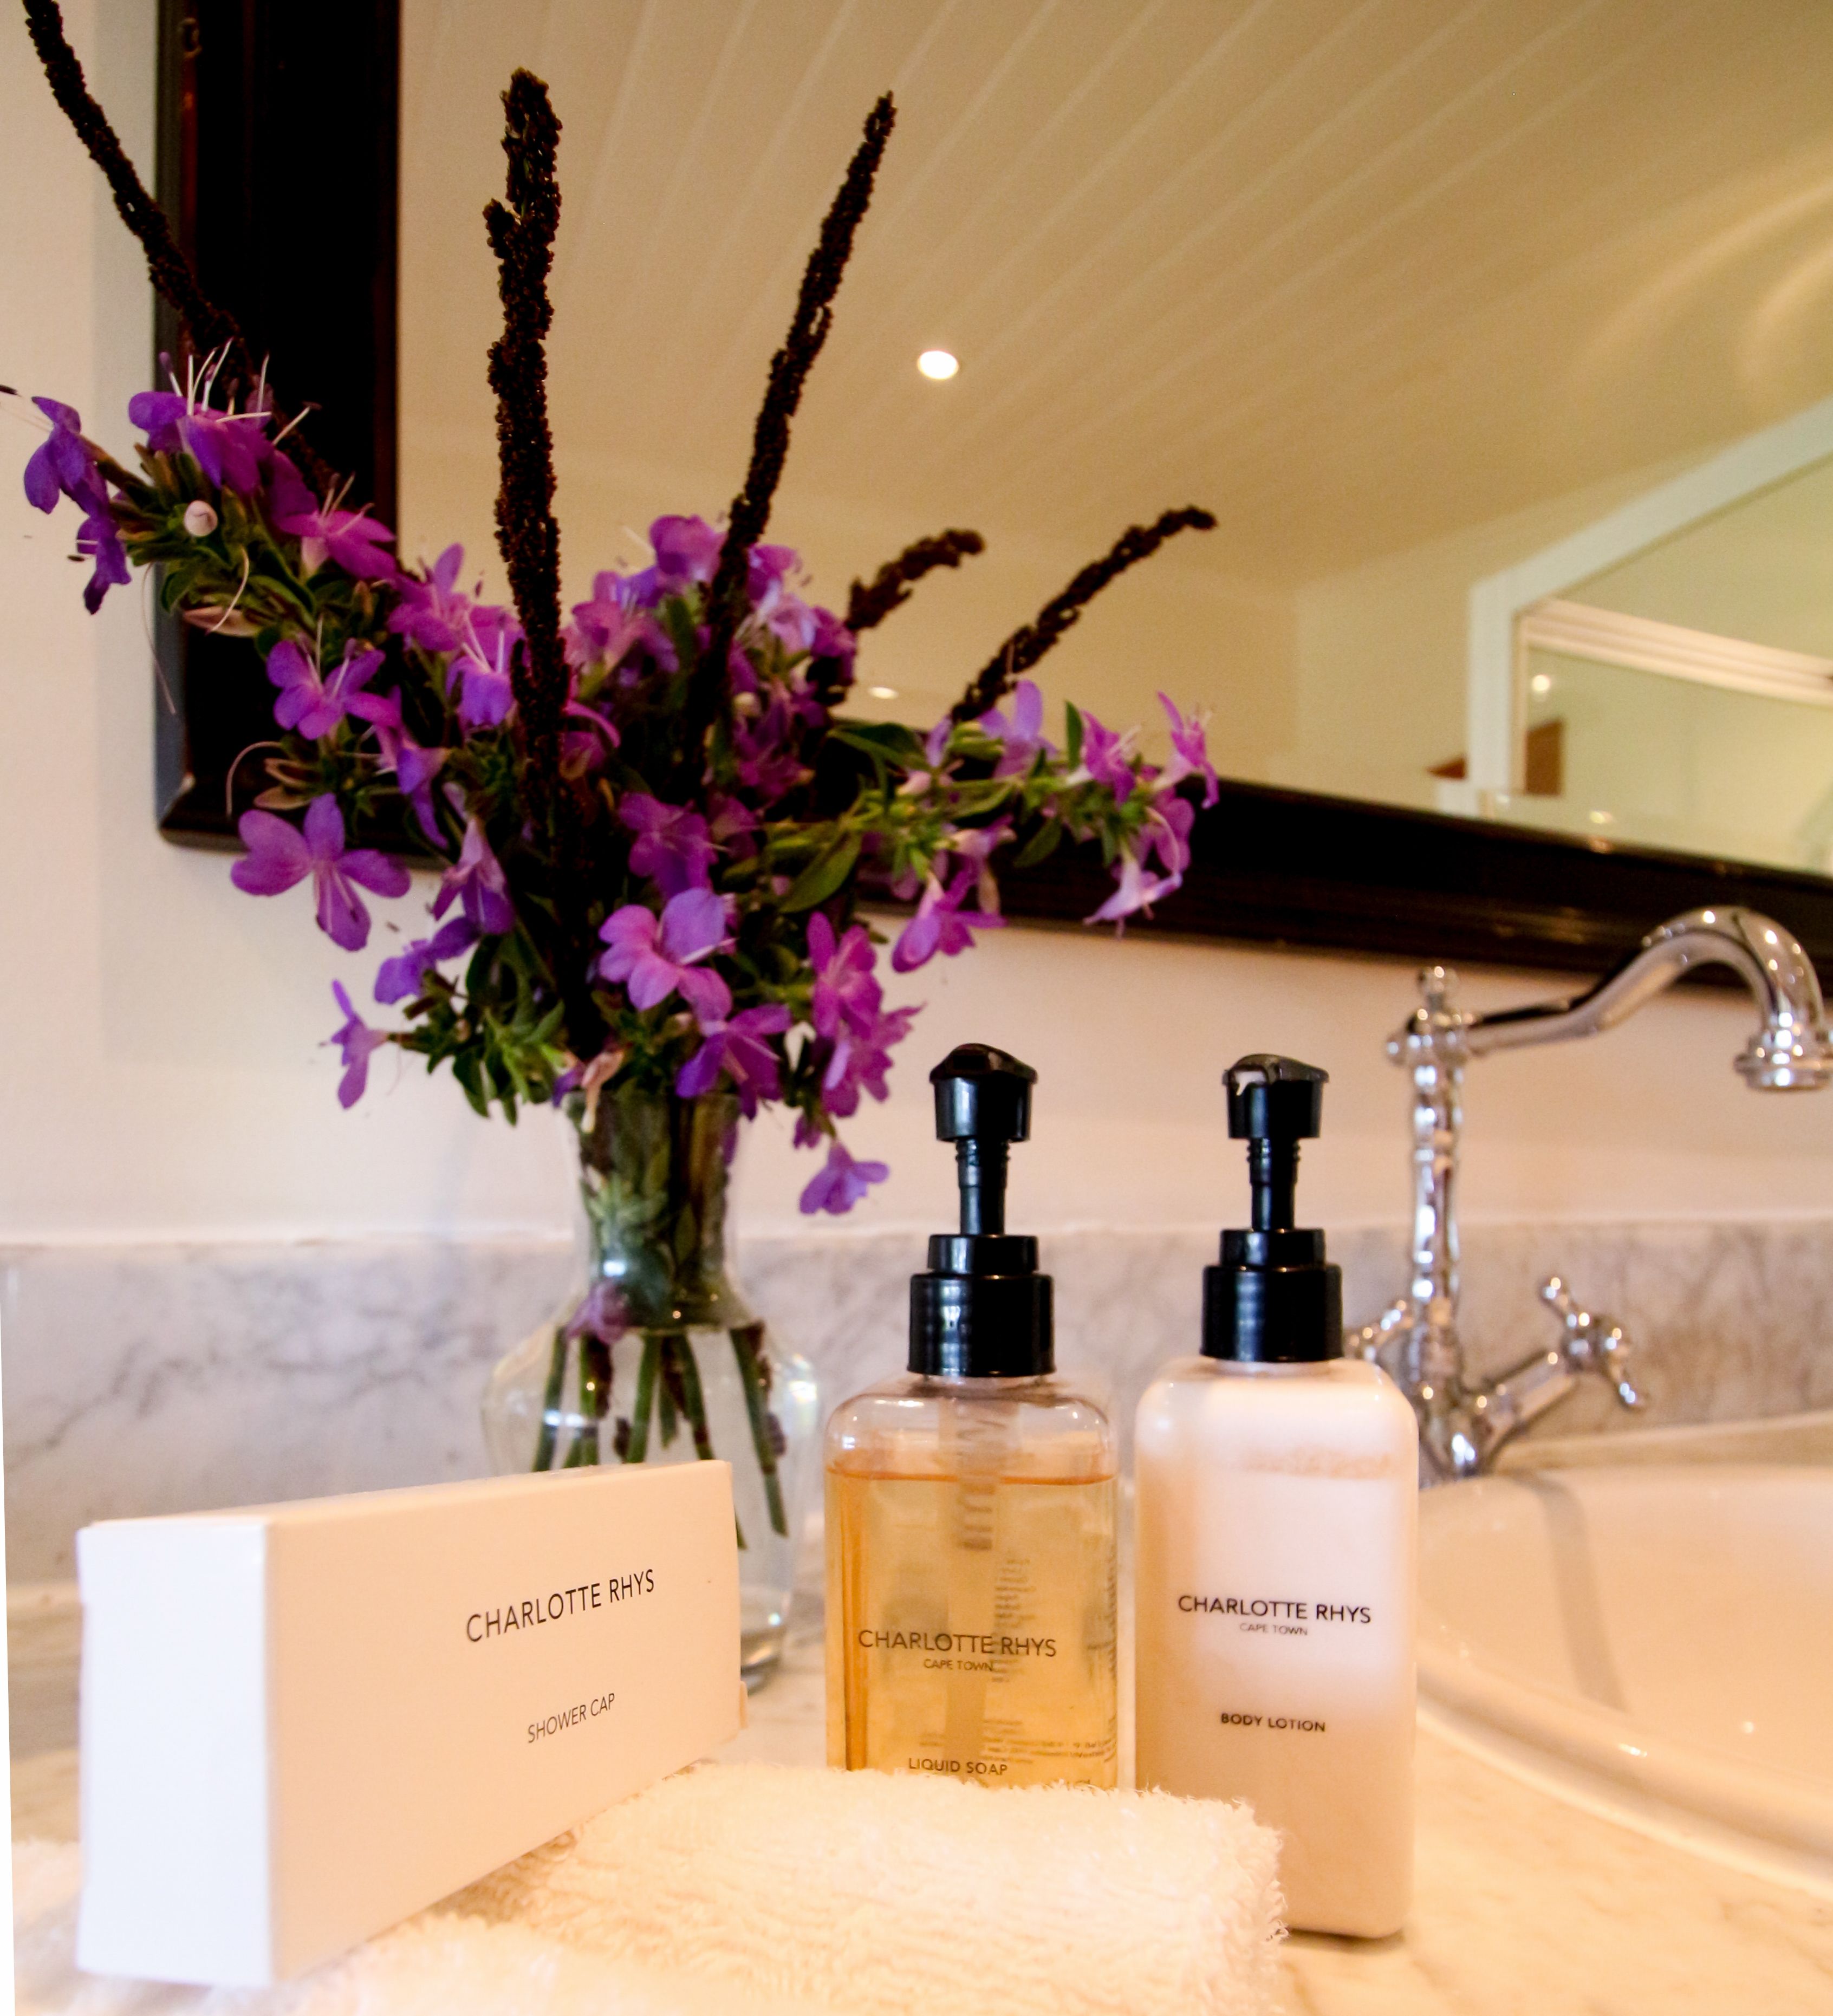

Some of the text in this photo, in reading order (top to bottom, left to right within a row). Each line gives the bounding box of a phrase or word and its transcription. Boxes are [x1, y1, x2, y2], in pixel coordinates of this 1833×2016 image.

[466, 1569, 655, 1642] CHARLOTTE RHYS
[1178, 1595, 1372, 1624] CHARLOTTE RHYS
[1239, 1623, 1308, 1636] CAPE TOWN
[858, 1630, 1057, 1657] CHARLOTTE RHYS
[924, 1659, 953, 1670] CAPE
[957, 1660, 994, 1673] TOWN
[528, 1693, 616, 1744] SHOWER CAP
[1220, 1713, 1326, 1732] BODY LOTION
[908, 1758, 1008, 1776] LIQUID SOAP
